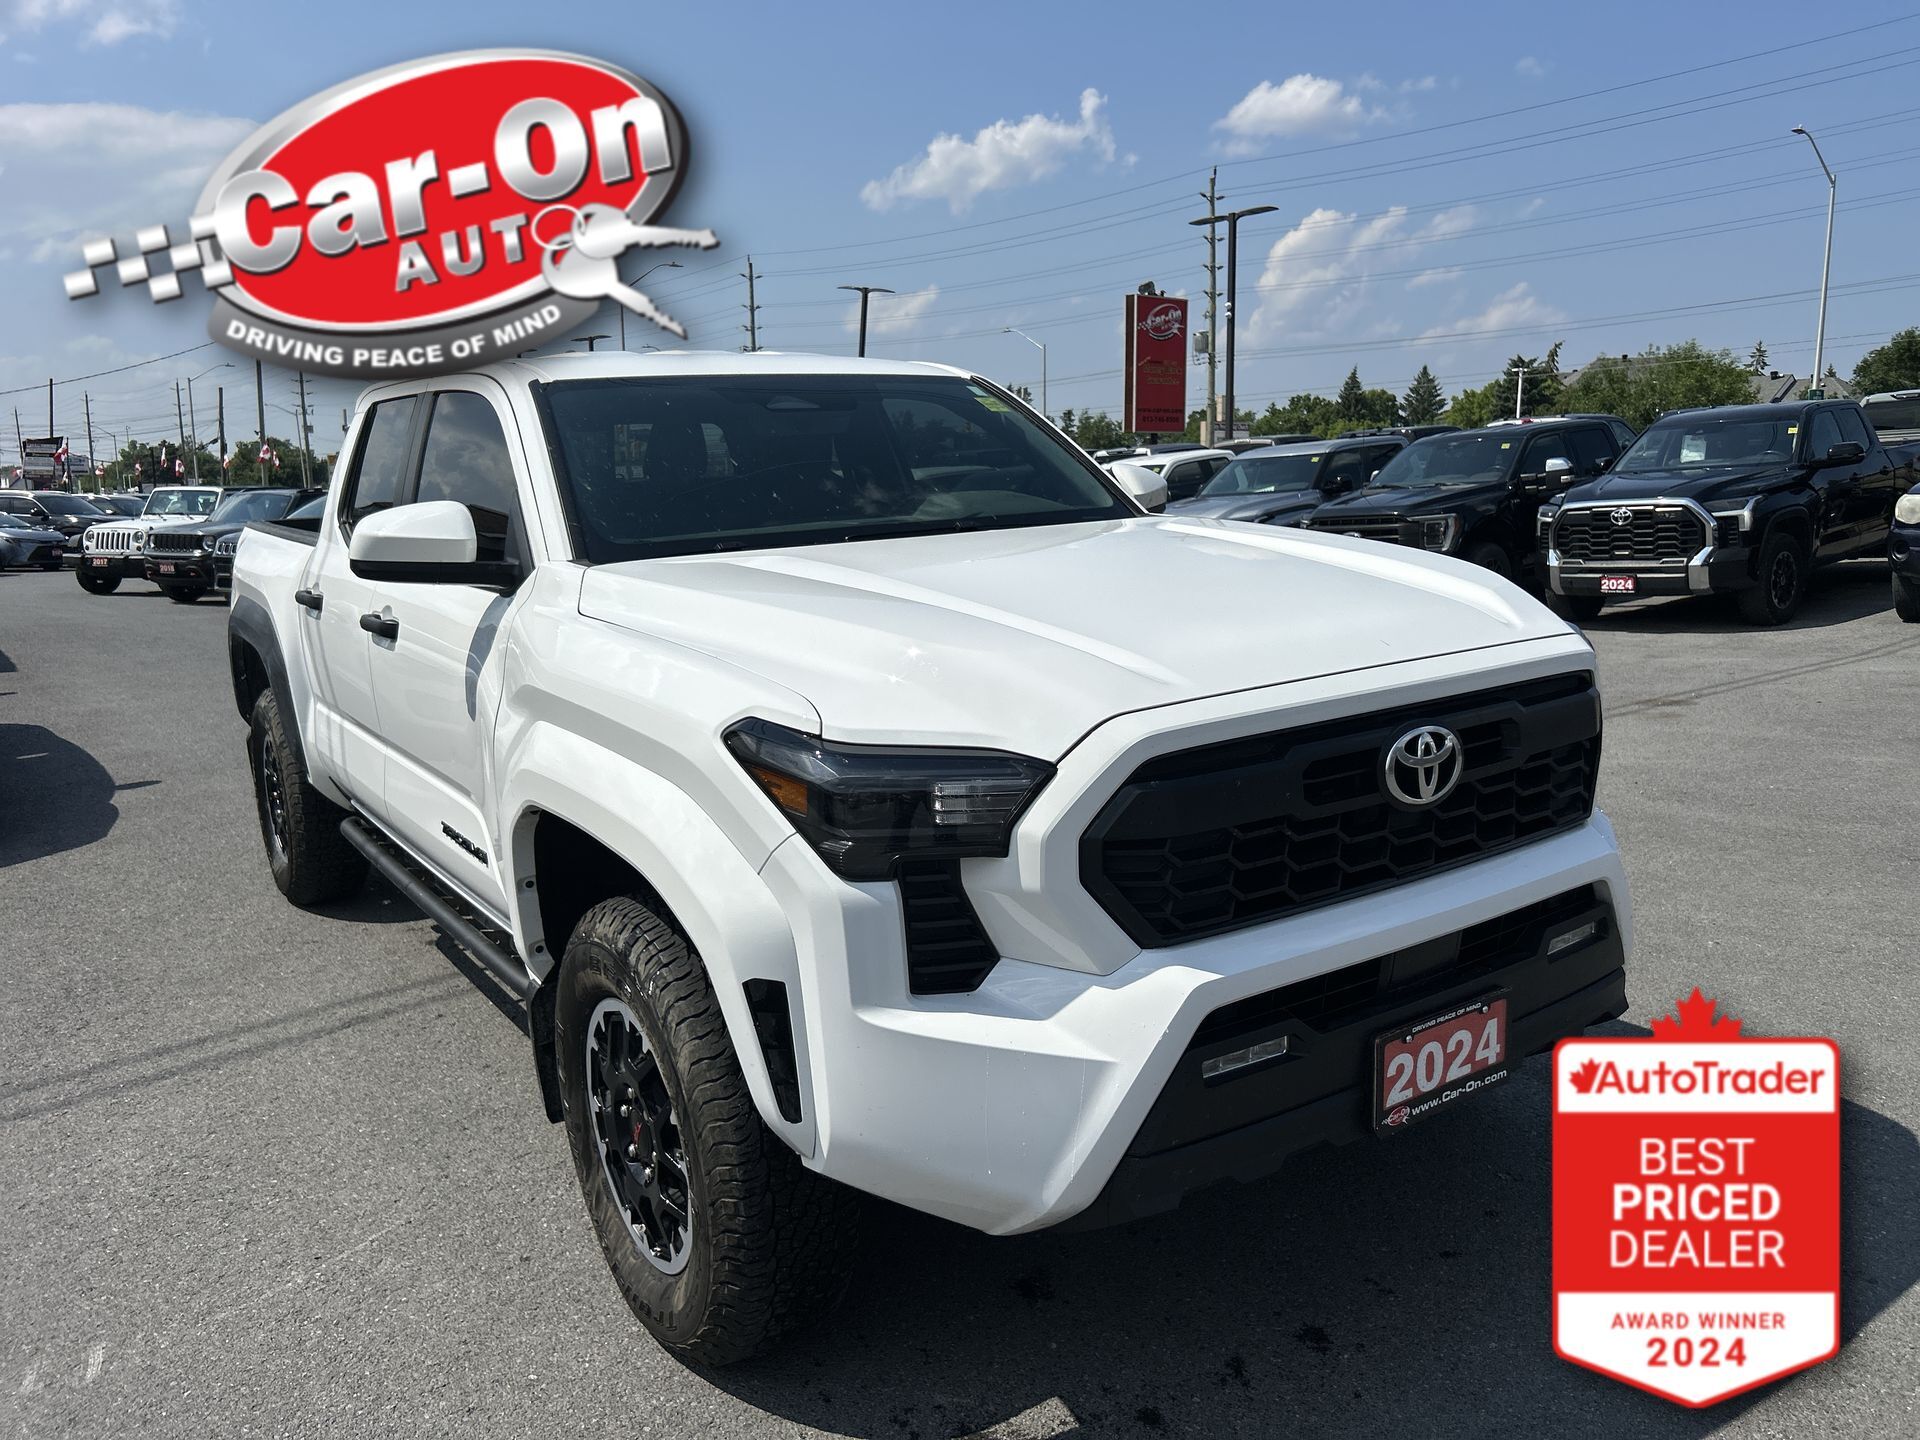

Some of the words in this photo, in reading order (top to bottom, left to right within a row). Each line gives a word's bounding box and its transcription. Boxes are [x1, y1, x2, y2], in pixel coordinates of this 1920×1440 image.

[1601, 579, 1633, 590] 2024
[1412, 1019, 1436, 1033] DRIVING
[1437, 1011, 1457, 1023] PEACE
[1457, 1008, 1466, 1016] OF
[1466, 1002, 1482, 1012] MIND
[1386, 1018, 1500, 1108] 2024
[1411, 1069, 1507, 1116] www.Car-On.com
